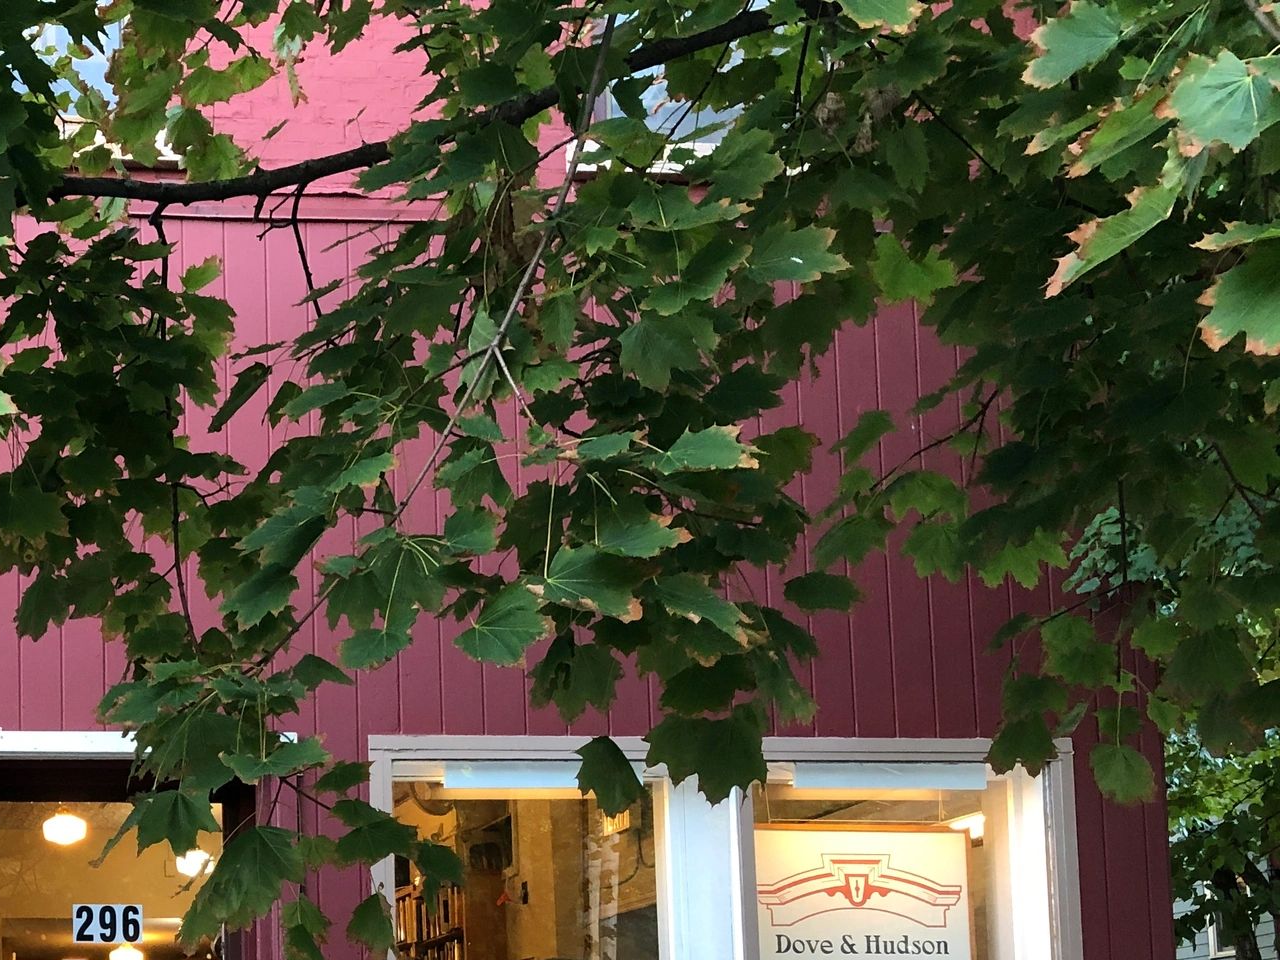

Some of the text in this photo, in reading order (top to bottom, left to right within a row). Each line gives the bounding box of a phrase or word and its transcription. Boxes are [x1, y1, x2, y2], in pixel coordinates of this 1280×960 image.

[75, 905, 141, 942] 296
[775, 934, 950, 955] Dove & Hudson
